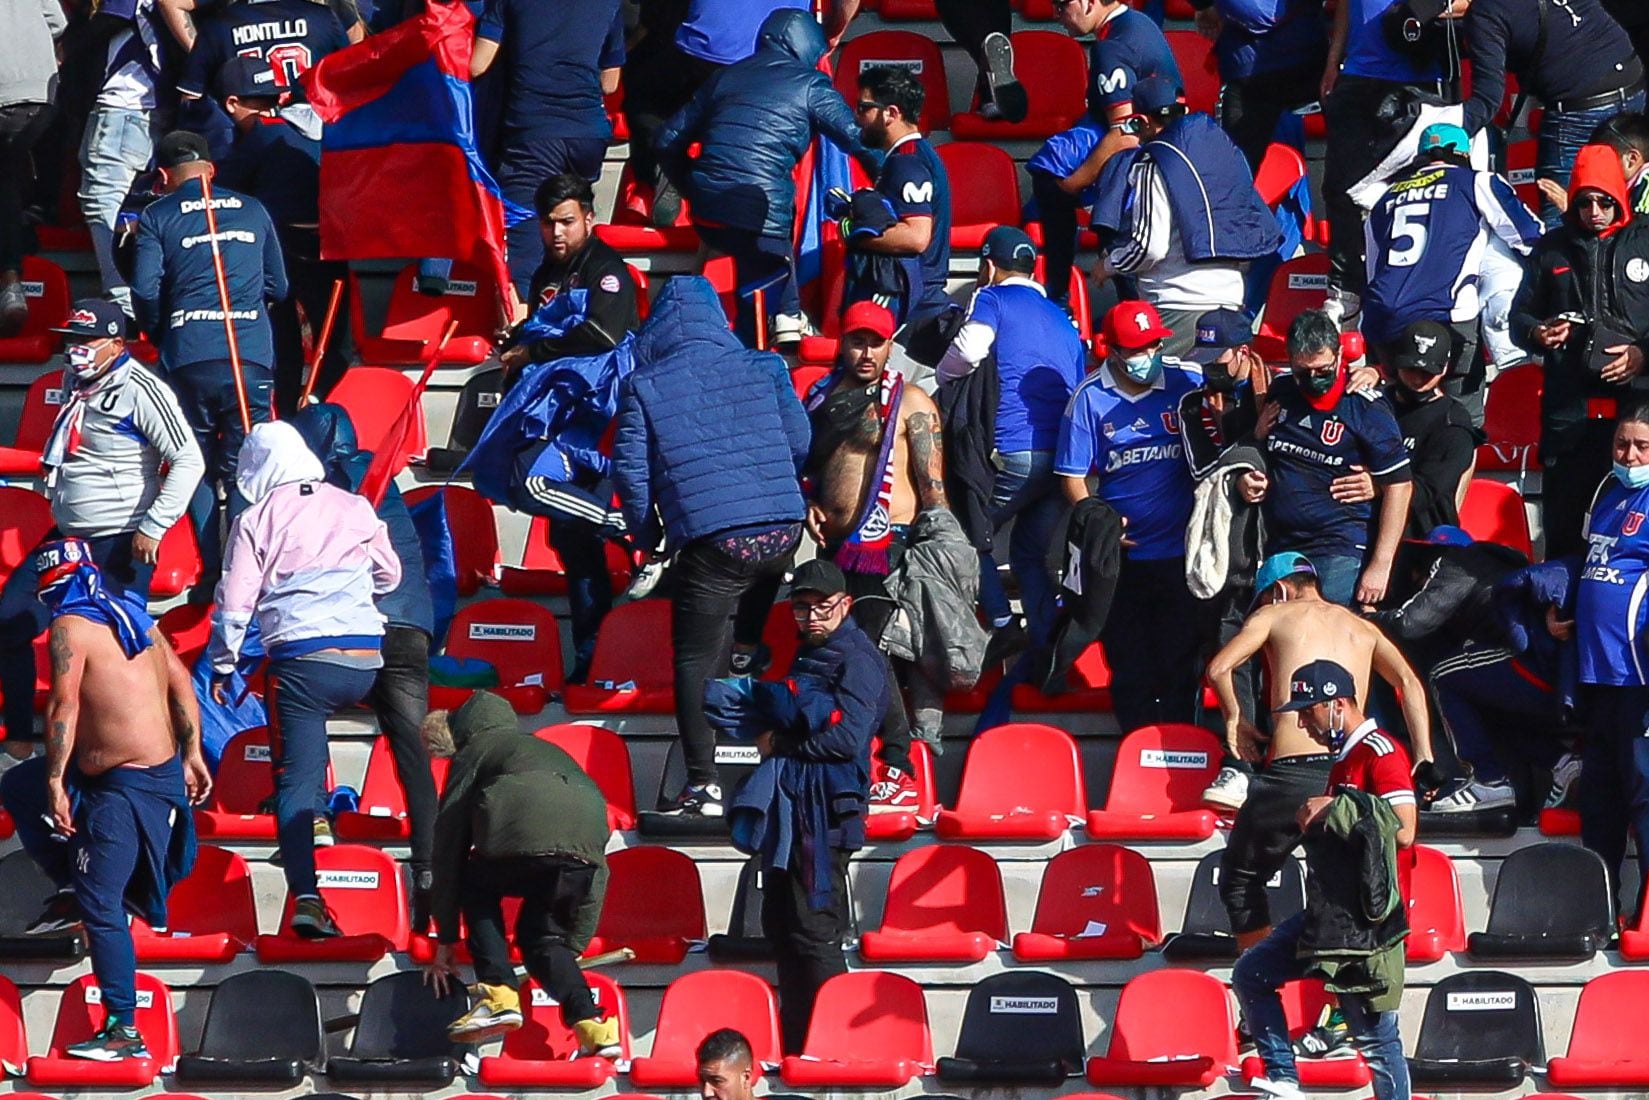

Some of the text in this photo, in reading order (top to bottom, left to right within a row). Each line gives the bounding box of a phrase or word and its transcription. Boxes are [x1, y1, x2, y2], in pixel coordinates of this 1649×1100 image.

[231, 18, 308, 46] MONTILLO
[1386, 183, 1448, 214] PONCE
[1388, 202, 1431, 267] 5
[185, 307, 258, 322] PETRORAS
[1122, 445, 1180, 466] BETANO
[484, 627, 534, 638] HABILITADO
[715, 751, 759, 760] ABILITADO
[1156, 754, 1205, 766] HABILITADO
[326, 874, 376, 885] HABILITADO
[1004, 1000, 1056, 1010] HABILITADO
[1463, 996, 1513, 1006] HABILITADO
